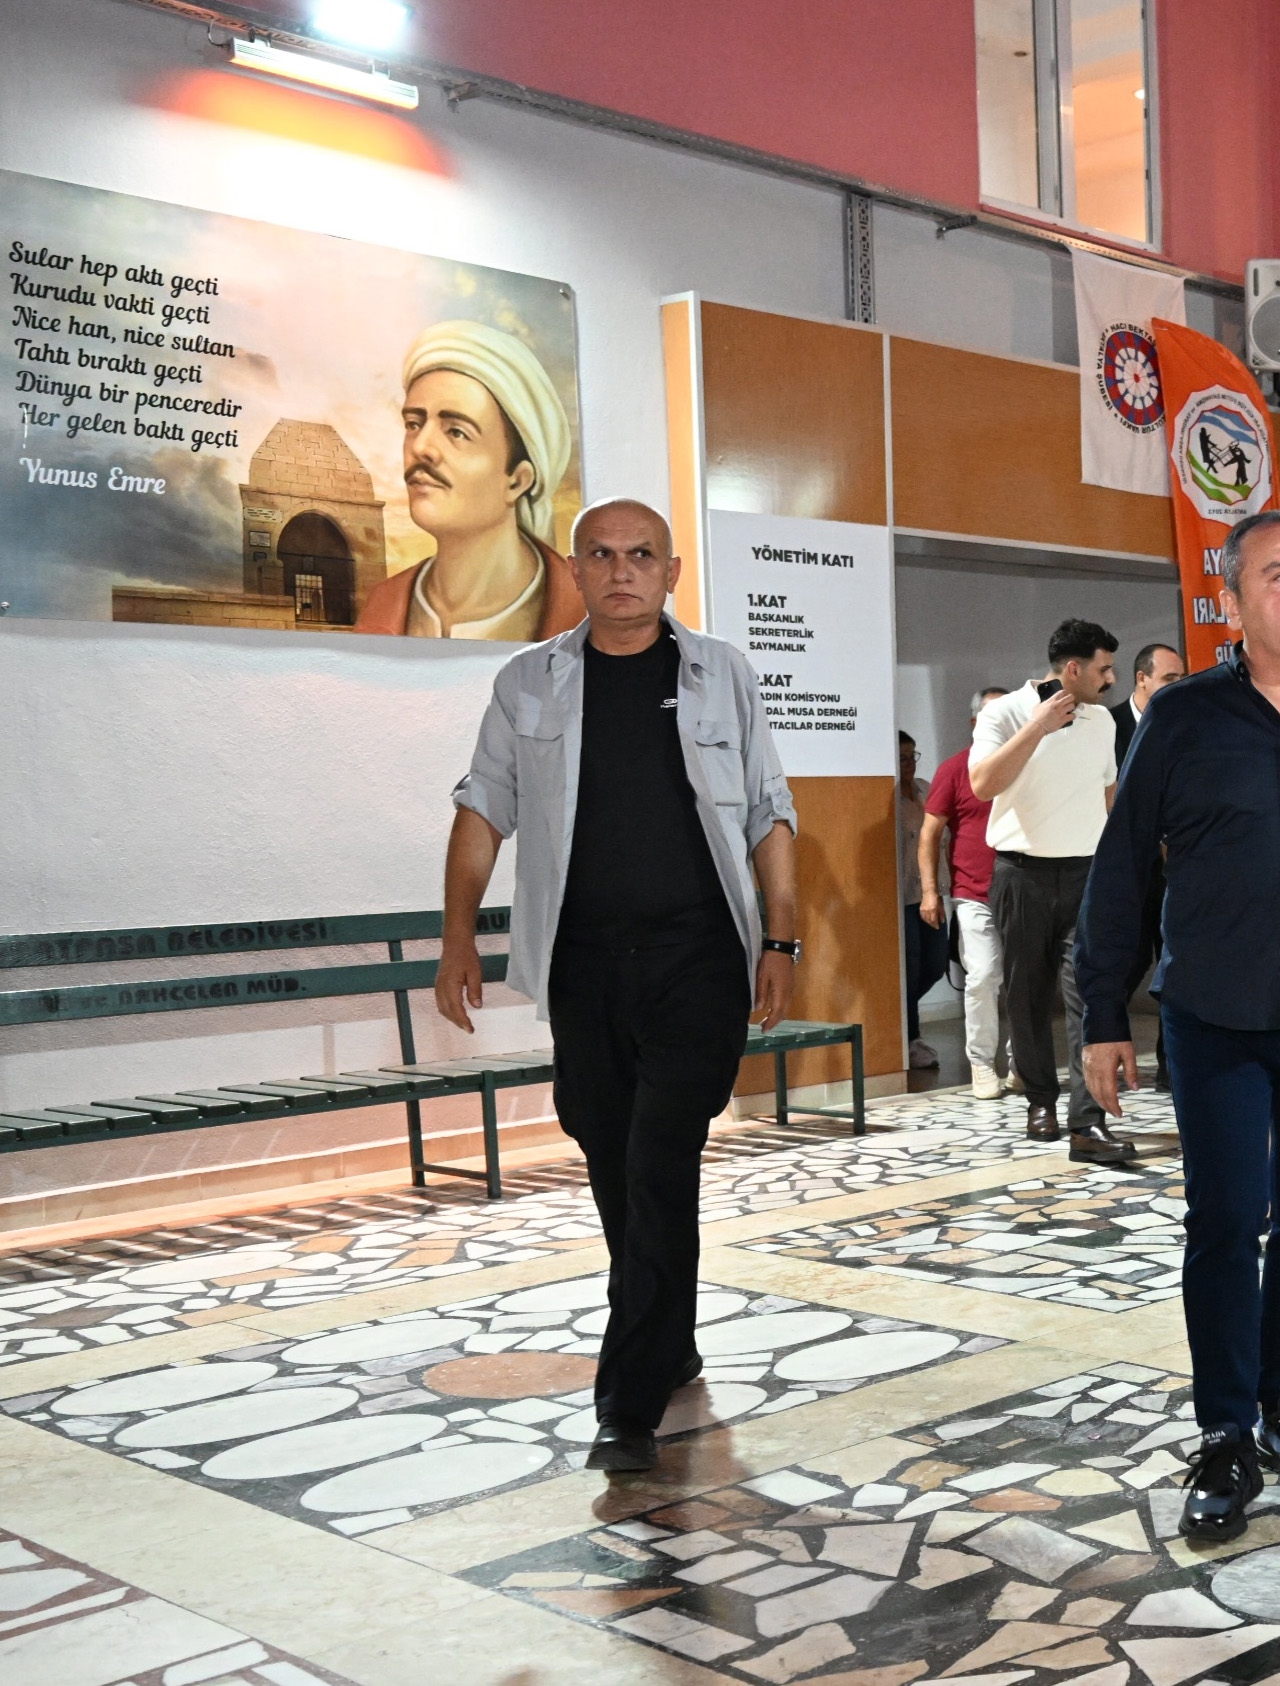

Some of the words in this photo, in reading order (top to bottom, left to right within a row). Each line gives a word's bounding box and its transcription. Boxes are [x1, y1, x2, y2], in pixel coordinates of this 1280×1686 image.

[9, 241, 73, 271] Sular
[80, 254, 118, 287] hep
[125, 264, 164, 287] aktı
[171, 275, 219, 298] geçti
[10, 272, 96, 307] Kurudu
[104, 292, 155, 316] vakti
[162, 304, 210, 327] geçti
[12, 305, 60, 332] Nice
[68, 316, 117, 344] han,
[124, 326, 165, 347] nice
[171, 334, 235, 358] sultan
[14, 338, 70, 365] Tahtı
[78, 349, 147, 375] bıraktı
[154, 364, 202, 387] geçti
[16, 370, 91, 407] Dünya
[100, 382, 129, 403] bir
[134, 391, 242, 418] penceredir
[19, 402, 60, 427] Her
[67, 412, 126, 438] gelen
[134, 418, 185, 441] baktı
[191, 429, 239, 452] geçti
[20, 458, 97, 489] Yunus
[108, 467, 166, 495] Emre
[752, 545, 818, 565] YÖNETİM
[822, 553, 854, 568] KATI
[747, 594, 787, 608] 1.KAT
[748, 612, 804, 624] BAŞKANLIK
[749, 627, 814, 639] SEKRETERLİK
[749, 641, 806, 653] SAYMANLIK
[760, 693, 783, 701] DIN
[785, 692, 840, 703] KOMİSYONU
[766, 707, 785, 716] DAL
[788, 707, 815, 717] MUSA
[817, 706, 857, 717] DERNEĞİ
[769, 722, 813, 730] TACILAR
[815, 721, 855, 731] DERNEĞİ
